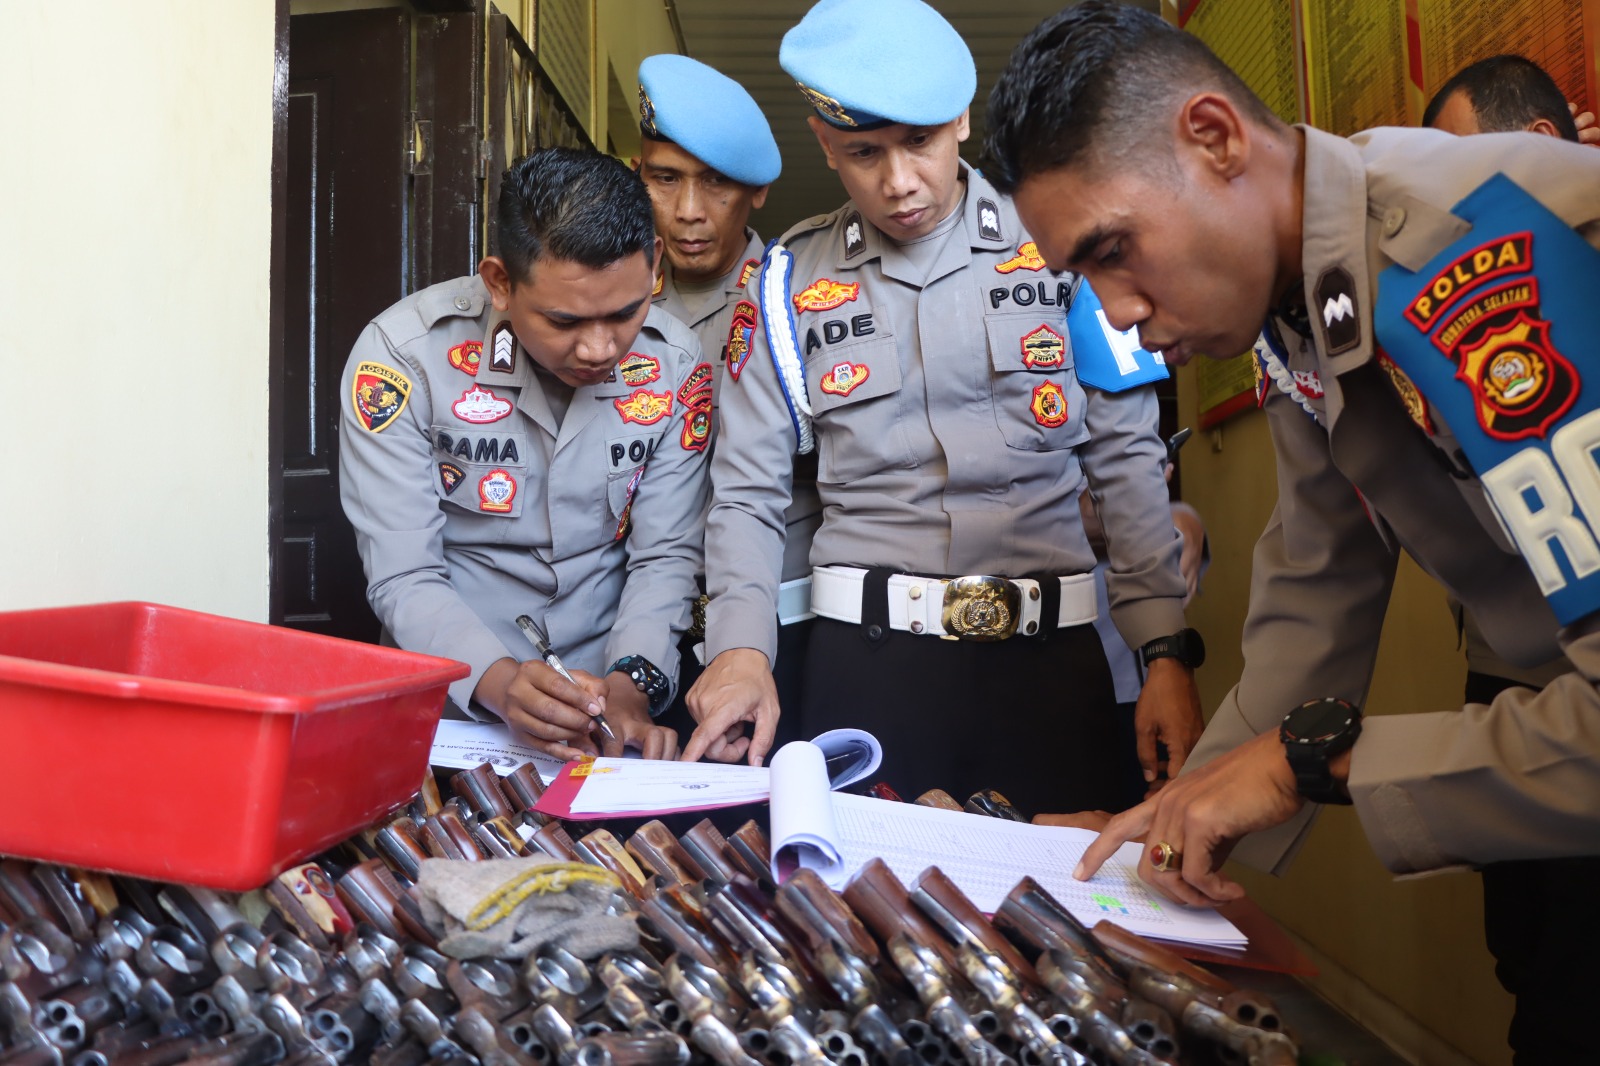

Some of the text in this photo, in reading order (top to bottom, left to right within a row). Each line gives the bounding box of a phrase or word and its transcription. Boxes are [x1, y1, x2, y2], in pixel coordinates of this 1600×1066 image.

[1414, 240, 1519, 320] POLDA
[806, 313, 876, 355] ADE
[361, 365, 408, 389] LOGISTIK
[438, 431, 520, 463] RAMA
